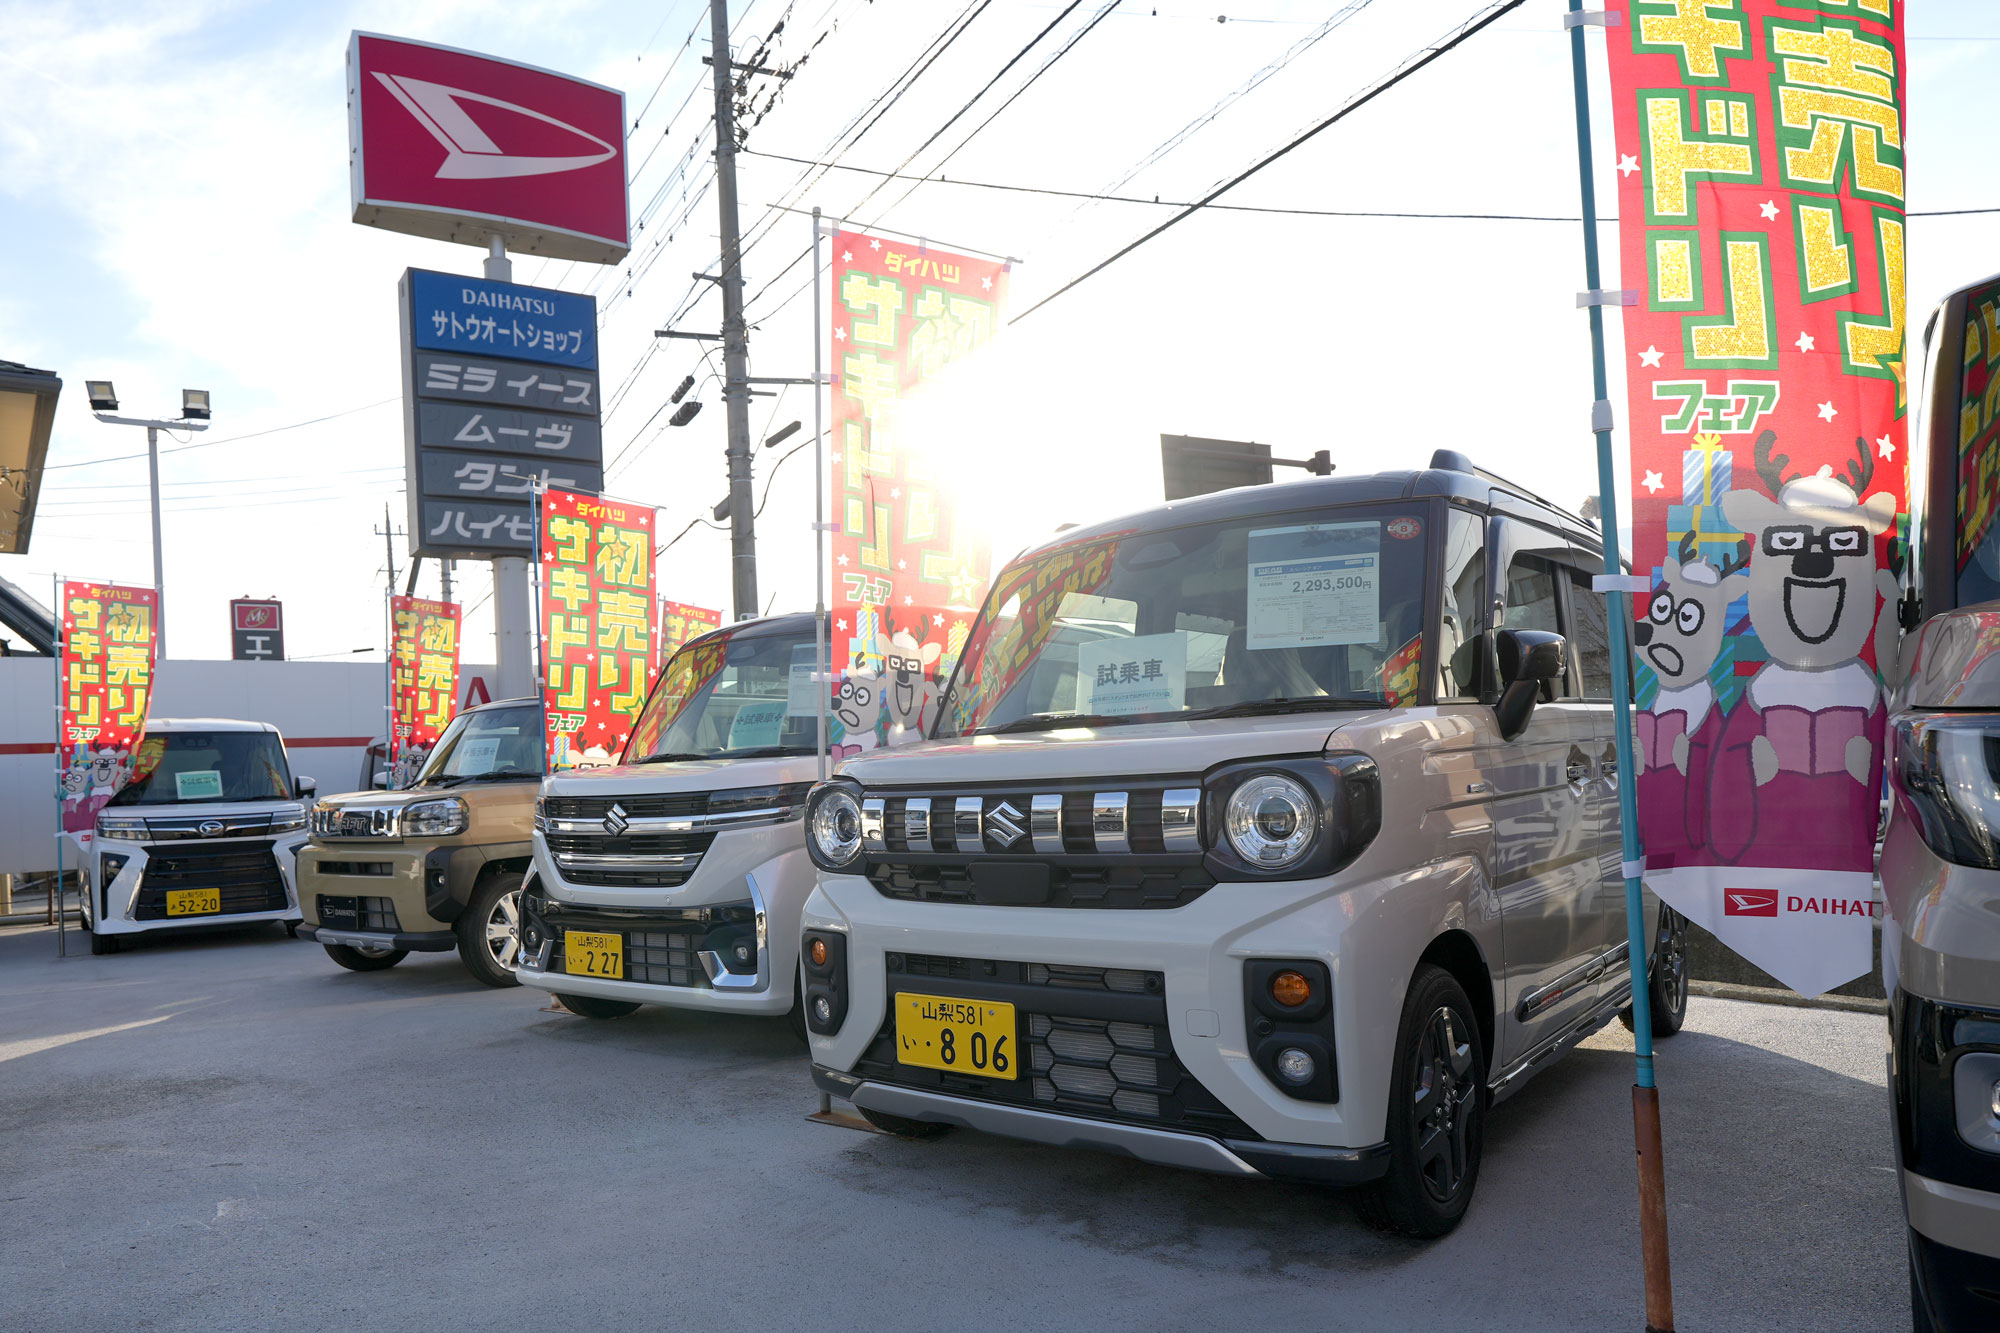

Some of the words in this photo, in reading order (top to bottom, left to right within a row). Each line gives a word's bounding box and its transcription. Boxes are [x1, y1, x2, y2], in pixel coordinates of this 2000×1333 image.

[1768, 0, 1905, 372] 売り
[884, 250, 961, 284] ダイハツ
[462, 288, 555, 316] DAIHATSU
[431, 309, 583, 354] サトウオートショップ
[839, 269, 907, 575] サキドリ
[1651, 379, 1780, 435] フェア
[453, 414, 573, 450] ムーヴ
[454, 461, 576, 494] タント
[576, 502, 626, 523] ダイハツ
[91, 587, 132, 600] ダイハツ
[843, 572, 893, 605] フェア
[1292, 575, 1372, 594] 2,293,500円
[412, 601, 443, 614] ダイハツ
[547, 514, 592, 713] サキドリ
[595, 522, 651, 715] 初売り
[68, 597, 103, 727] サキドリ
[105, 602, 151, 727] 初売り
[245, 636, 273, 661] エ
[394, 609, 419, 725] サキドリ
[418, 614, 457, 727] 初売り
[1097, 658, 1163, 687] 試乗車
[67, 727, 101, 741] フェア
[547, 713, 587, 732] フェア
[178, 898, 217, 912] 52-20
[577, 935, 608, 949] 山梨581
[922, 1001, 983, 1026] 山梨581
